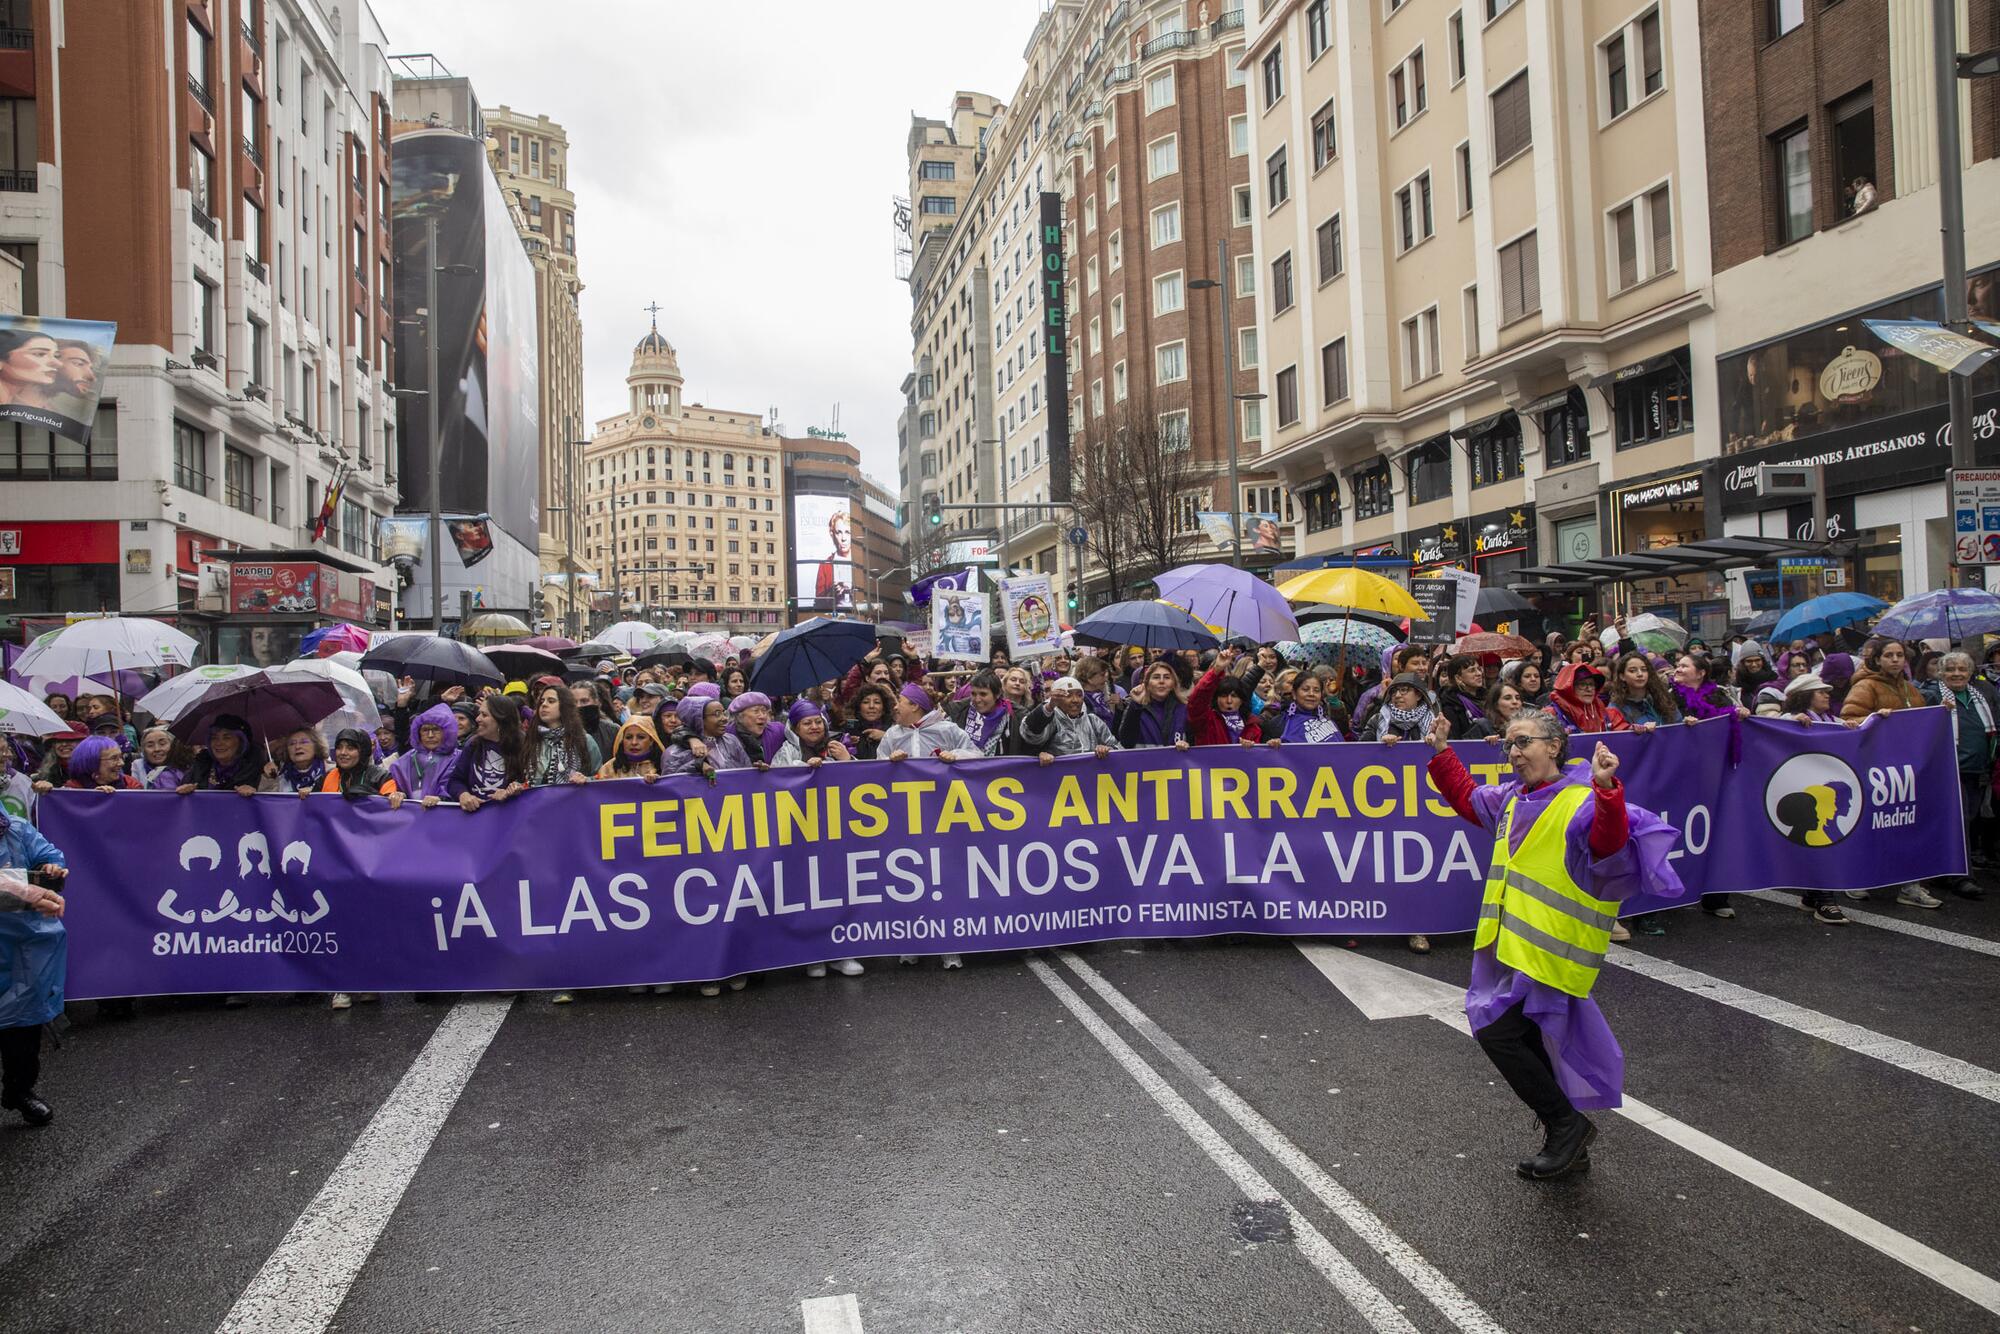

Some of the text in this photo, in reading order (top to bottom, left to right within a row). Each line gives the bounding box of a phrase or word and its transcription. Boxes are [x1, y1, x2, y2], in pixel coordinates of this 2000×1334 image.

[1045, 225, 1063, 354] HOTEL
[1846, 432, 1926, 460] ARTESANOS
[1624, 493, 1640, 509] FROM
[1682, 479, 1699, 493] LOVE
[1575, 539, 1587, 552] 45
[1868, 764, 1917, 807] 8M
[600, 756, 1586, 860] FEMINISTAS ANTIRRACIST
[1872, 804, 1916, 830] Madrid
[432, 882, 497, 951] ¡A
[519, 872, 651, 937] LAS
[673, 847, 943, 927] CALLES!
[966, 838, 1100, 899] NOS
[1117, 833, 1205, 887] VA
[1224, 831, 1306, 884] LA
[1322, 830, 1483, 883] VIDA
[831, 900, 1388, 944] COMISIÓN 8M MOVIMIENTO FEMINISTA DE MADRID
[152, 931, 202, 956] 8M
